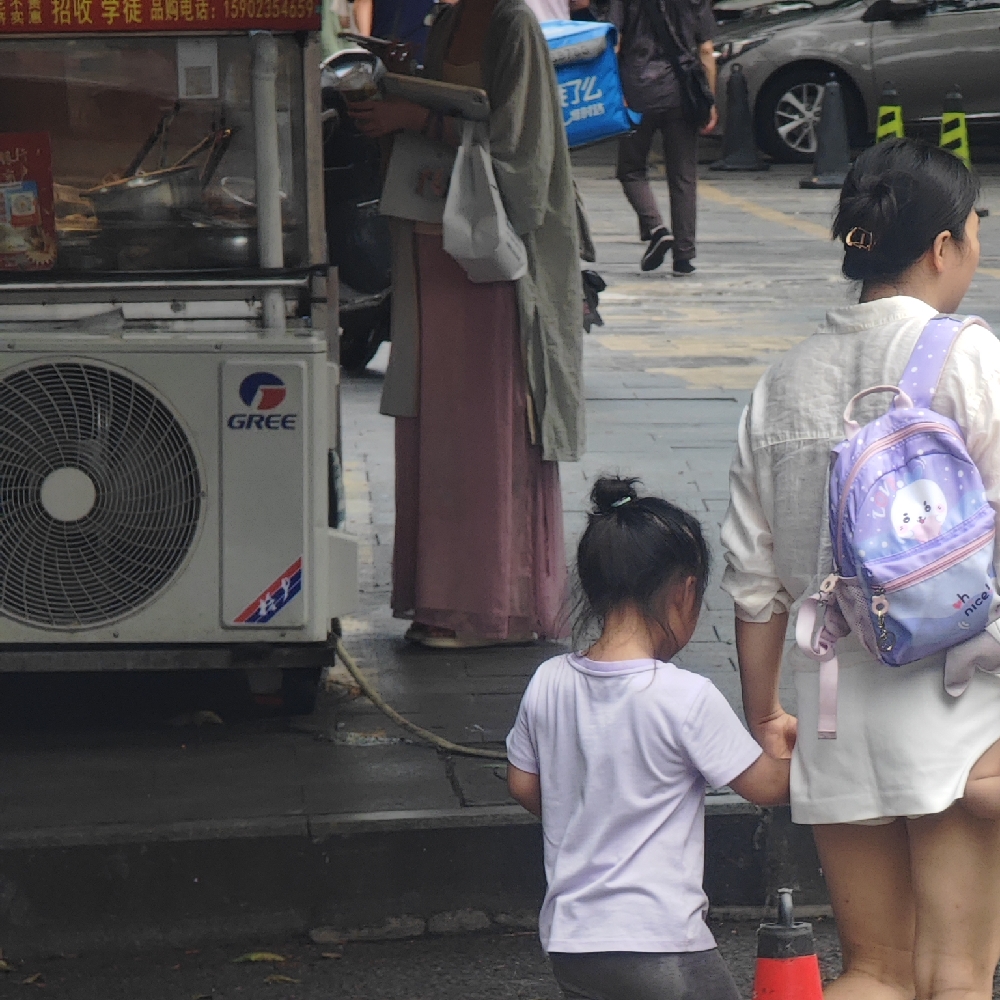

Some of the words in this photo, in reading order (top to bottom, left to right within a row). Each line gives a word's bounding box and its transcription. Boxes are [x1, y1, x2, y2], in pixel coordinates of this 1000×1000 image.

[52, 0, 93, 25] 招收
[101, 0, 143, 25] 学徒
[227, 413, 297, 430] GREE
